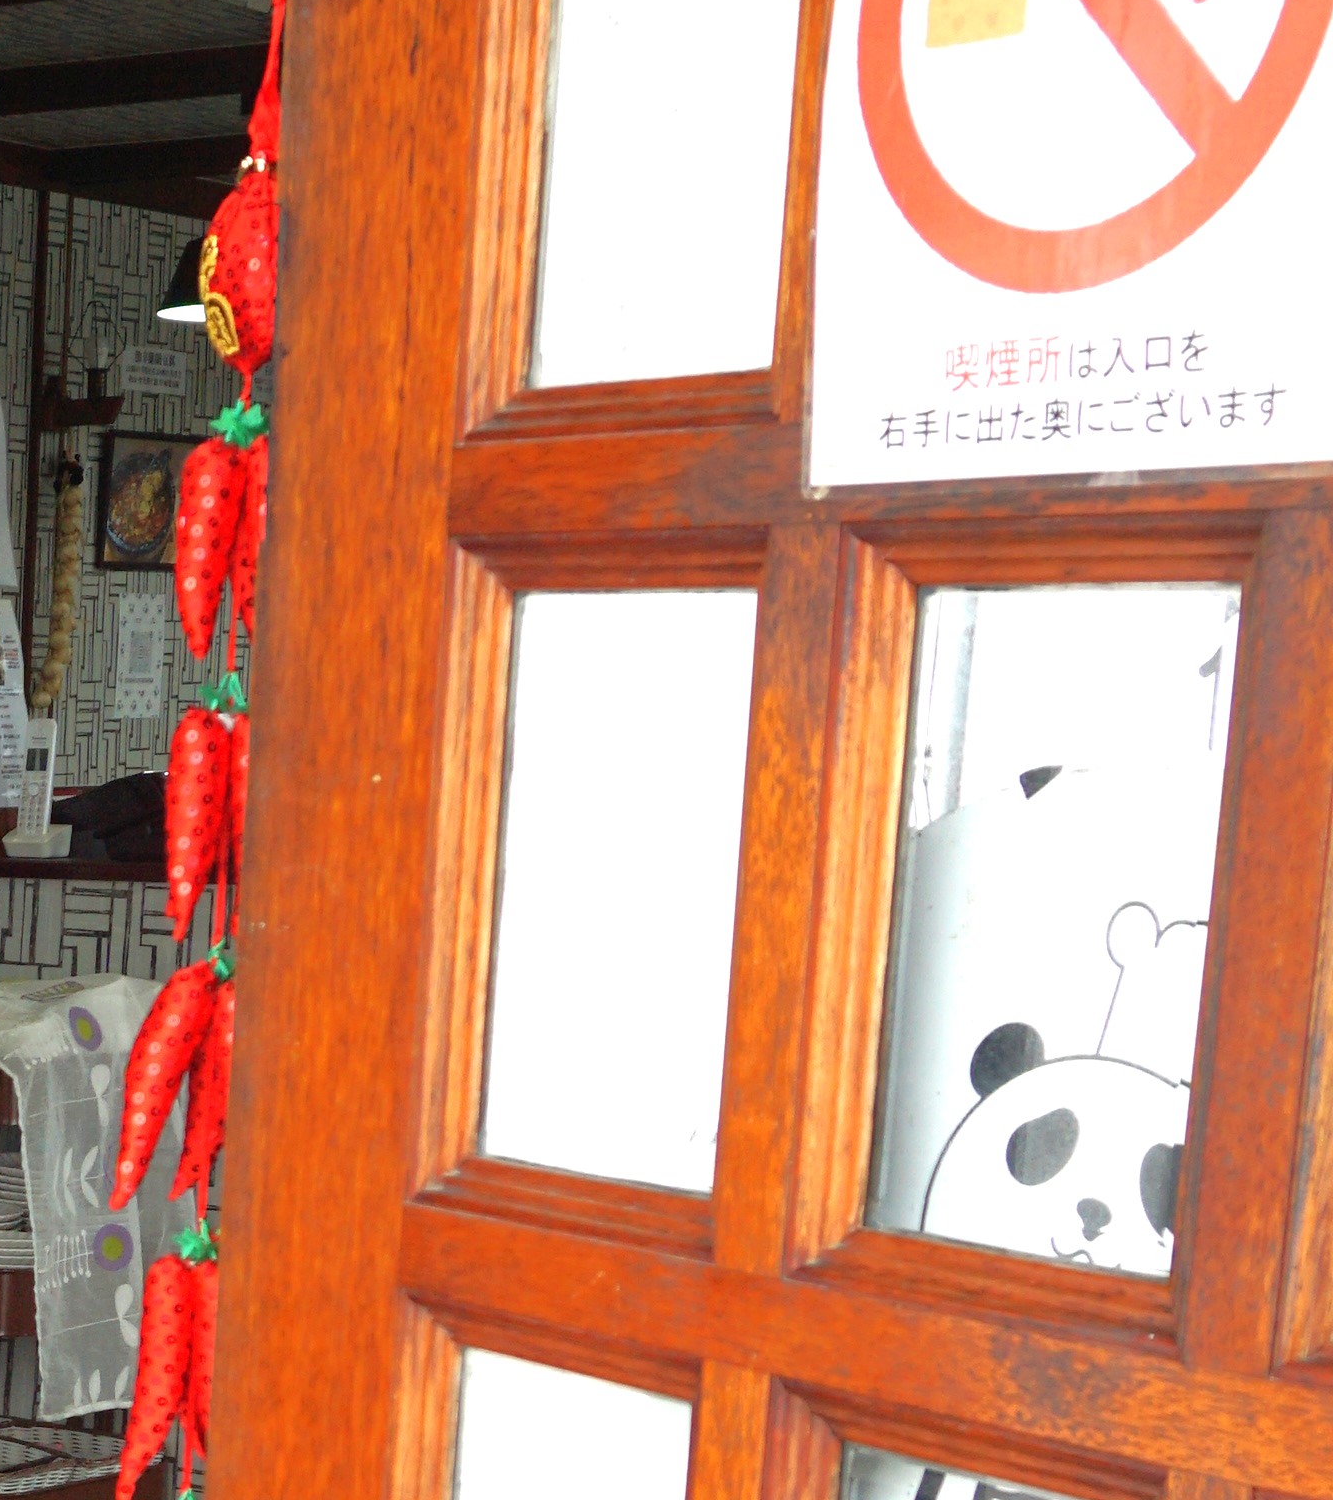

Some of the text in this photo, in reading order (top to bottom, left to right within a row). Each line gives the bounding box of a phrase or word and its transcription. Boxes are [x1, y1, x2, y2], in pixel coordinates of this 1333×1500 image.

[945, 329, 1209, 392] 喫煙所は入口を
[878, 382, 1287, 450] 右手に出た奥にございます
